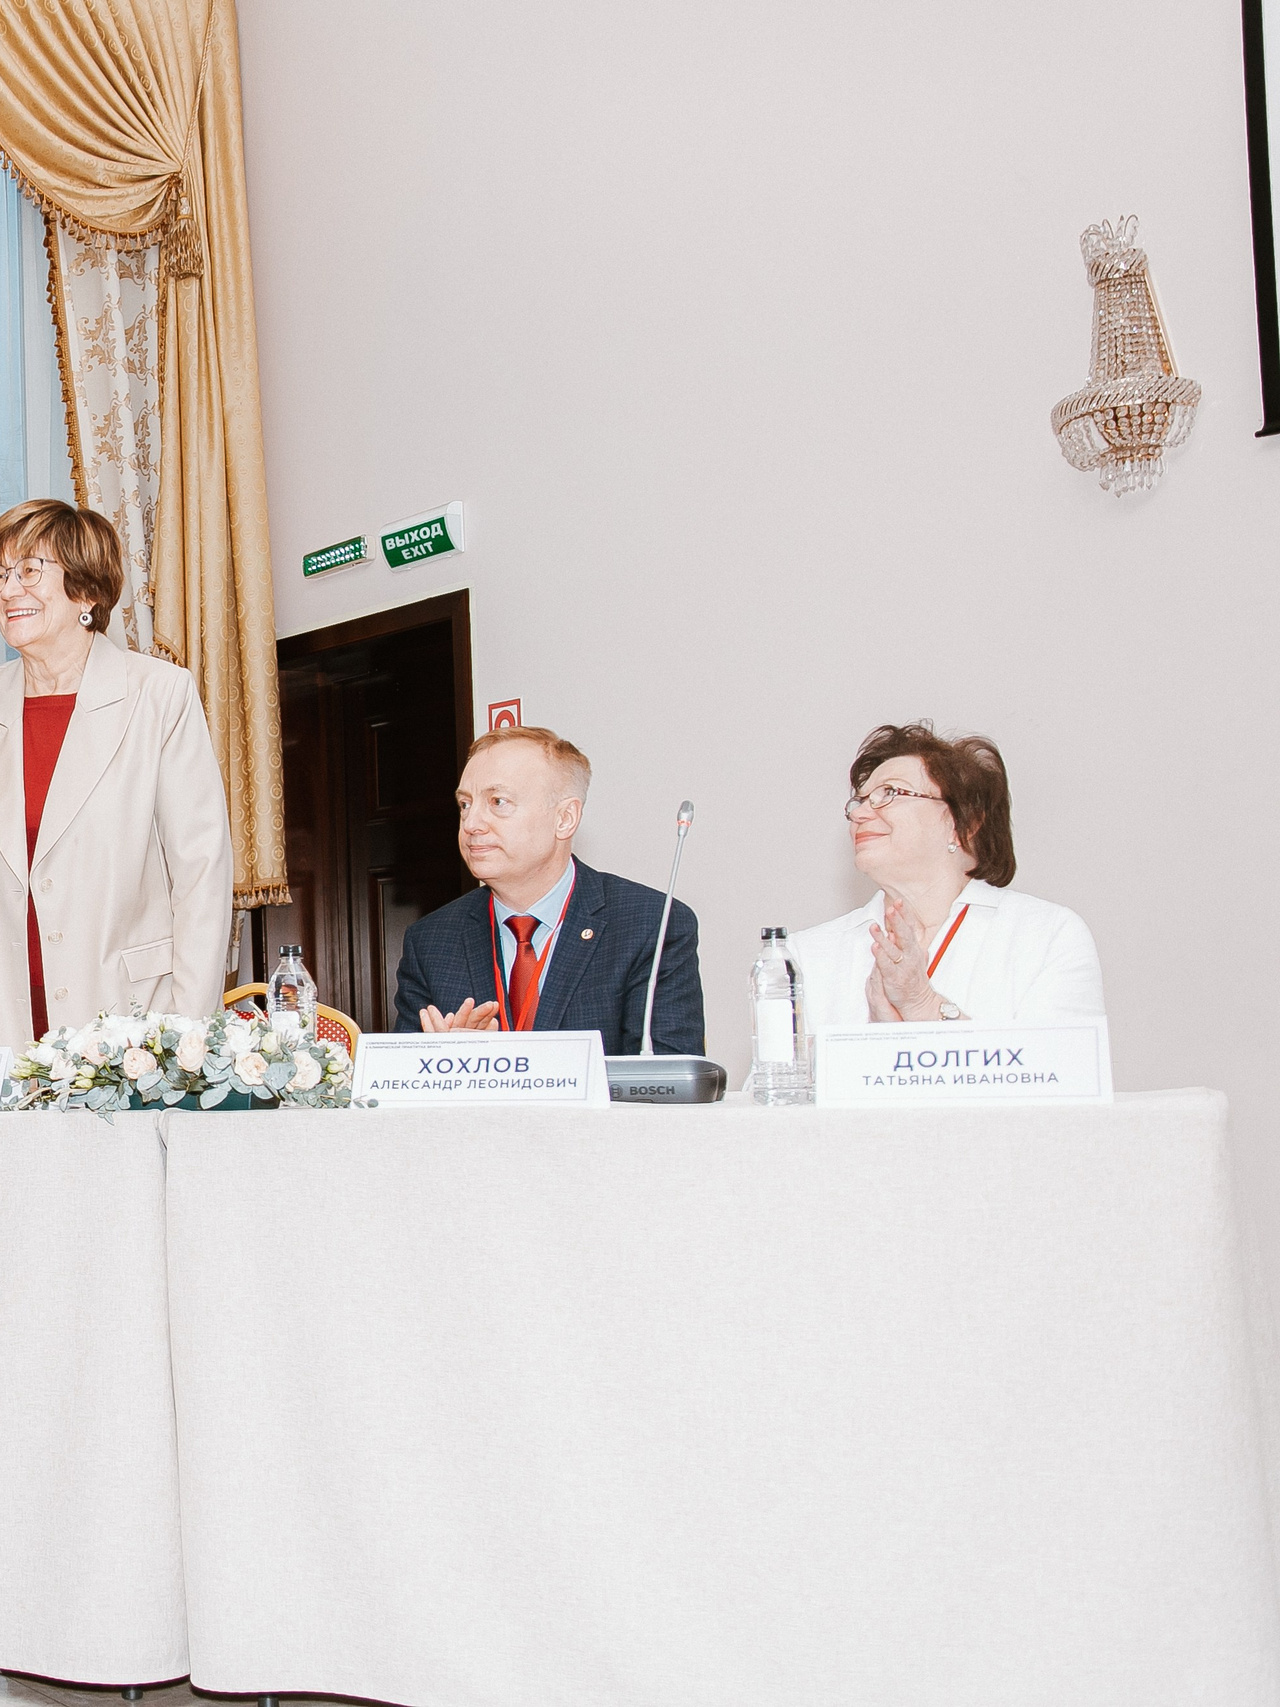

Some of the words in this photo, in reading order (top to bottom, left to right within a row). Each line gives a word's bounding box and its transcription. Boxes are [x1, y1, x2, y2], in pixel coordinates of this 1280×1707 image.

[385, 521, 444, 551] ВЫХОД
[401, 541, 435, 560] EXIT
[418, 1056, 530, 1074] ХОХЛОВ
[893, 1048, 1025, 1072] ДОЛГИХ
[370, 1079, 463, 1091] АЛЕКСАНДР
[467, 1077, 578, 1090] ЛЕОНИДОВИЧ
[862, 1073, 946, 1087] ТАТЬЯНА
[953, 1072, 1059, 1085] ИВАНОВНА
[629, 1086, 675, 1096] BOSCH
